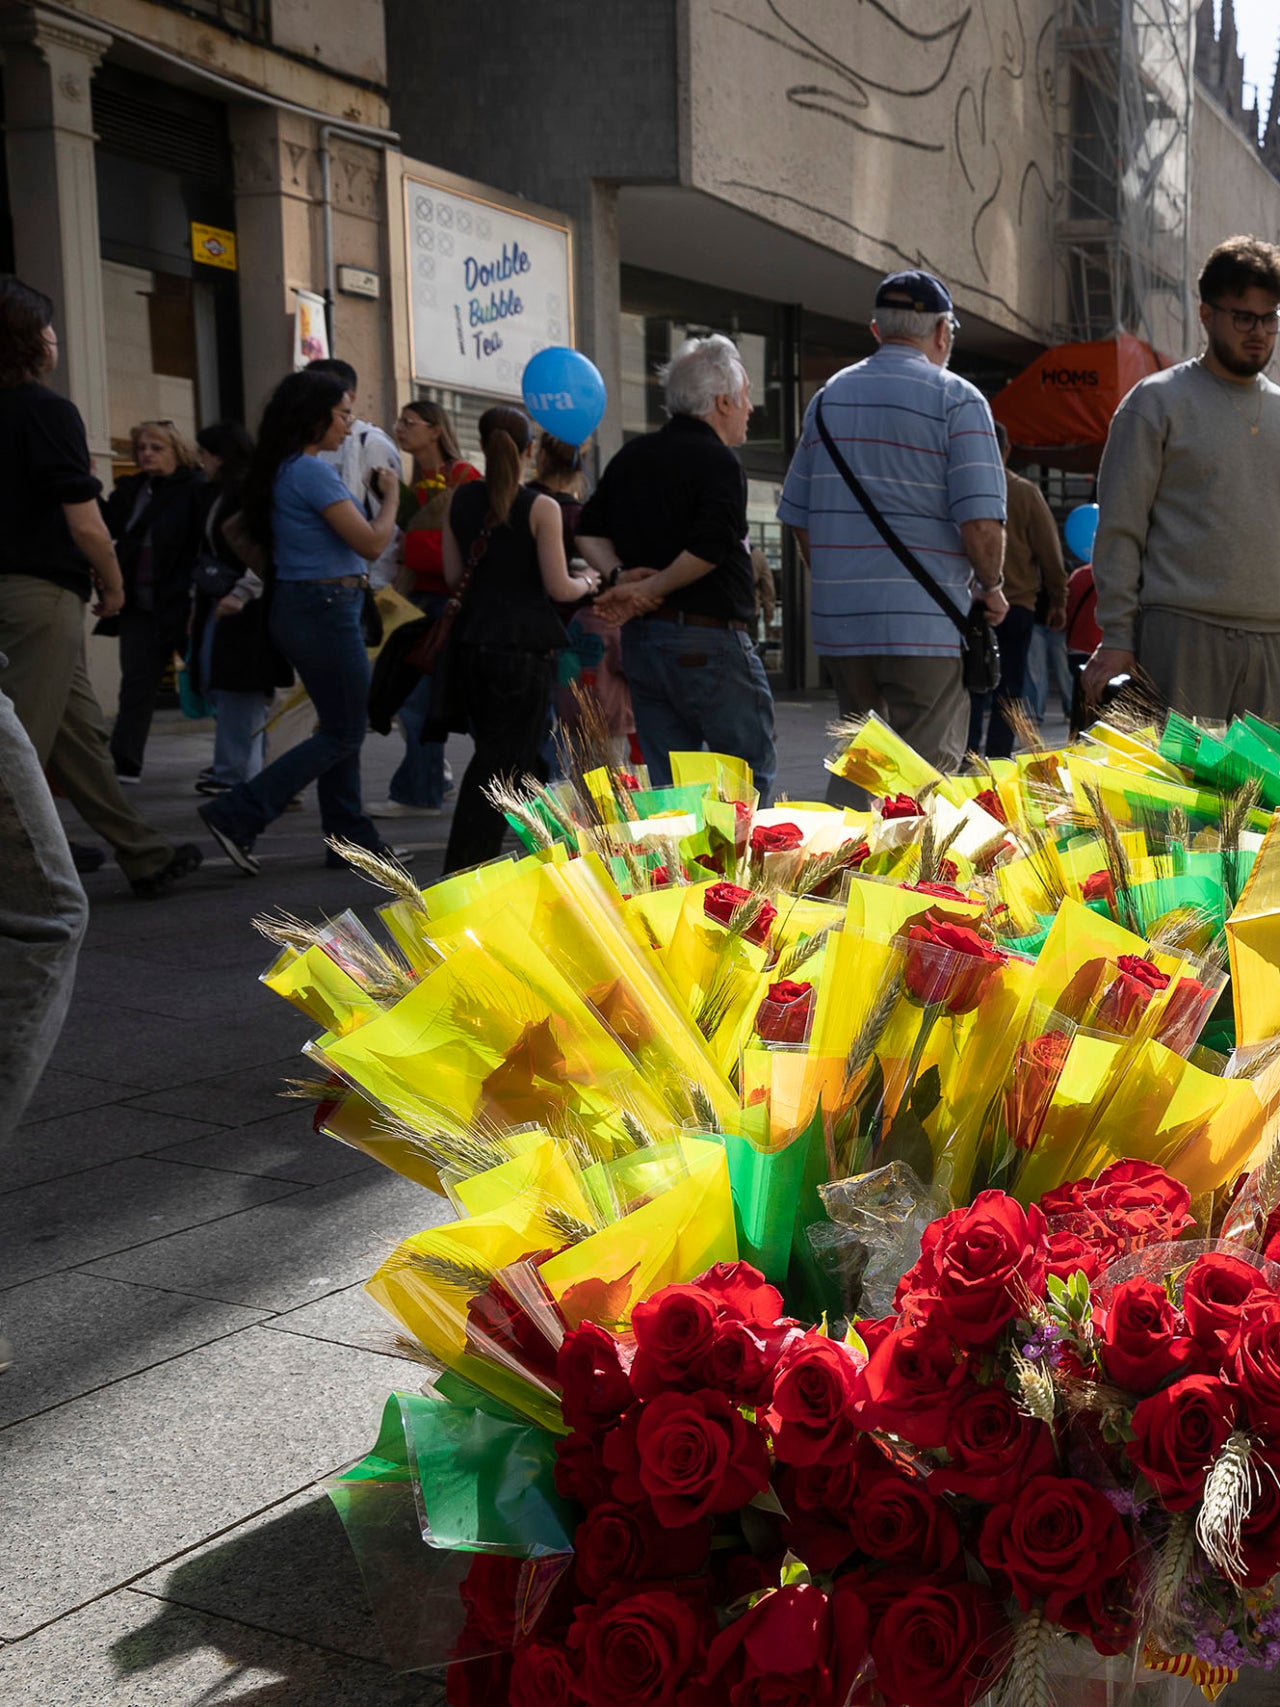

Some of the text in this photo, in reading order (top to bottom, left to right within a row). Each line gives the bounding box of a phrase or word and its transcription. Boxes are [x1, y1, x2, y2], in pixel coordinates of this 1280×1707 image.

[464, 241, 531, 291] Double
[469, 288, 523, 327] Bubble
[473, 331, 502, 360] Tea
[1041, 368, 1098, 385] HOMS
